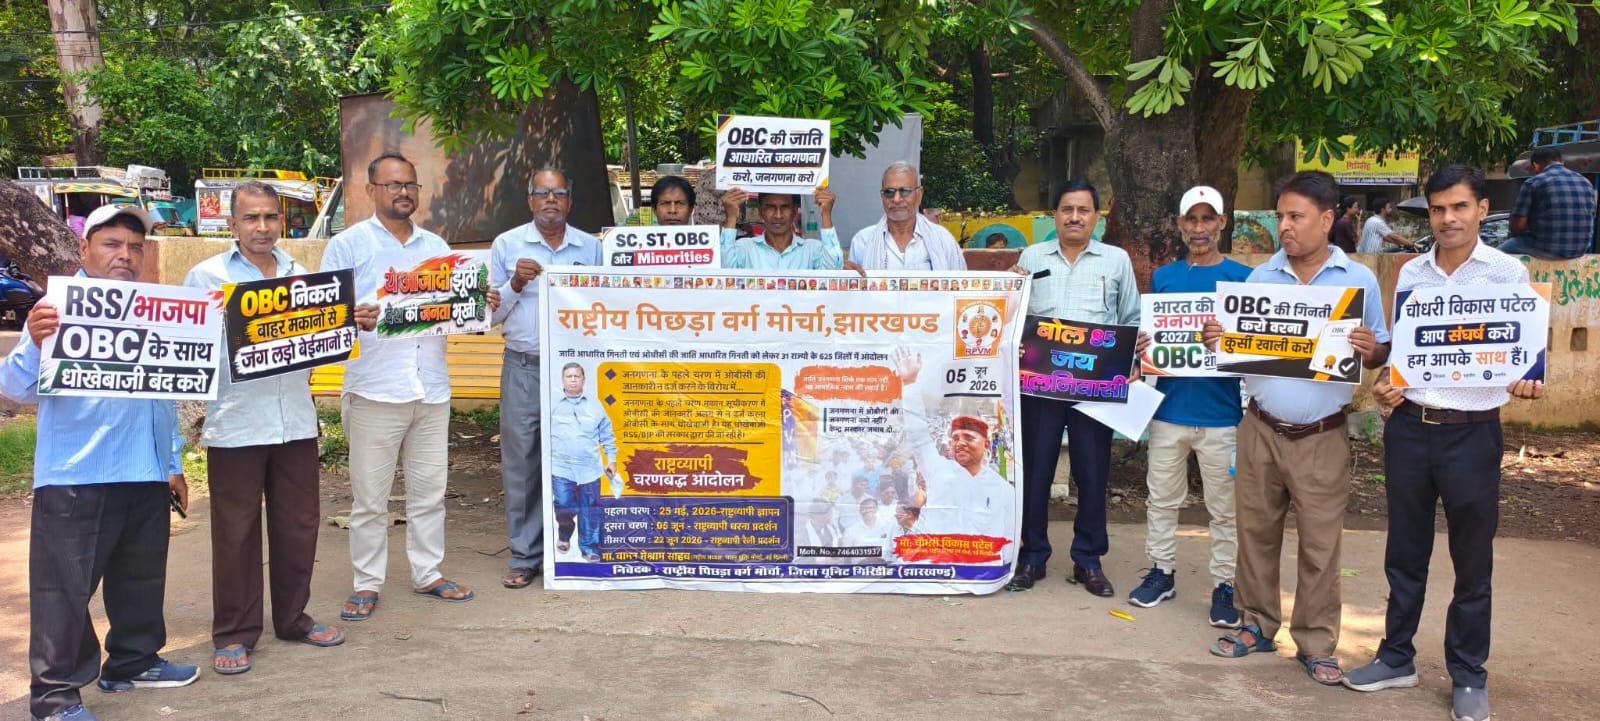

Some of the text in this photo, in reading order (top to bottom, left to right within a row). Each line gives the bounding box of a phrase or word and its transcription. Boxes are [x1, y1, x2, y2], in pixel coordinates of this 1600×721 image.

[727, 127, 823, 146] OBC की जाति
[729, 150, 821, 165] आधारित जनगणना
[732, 171, 815, 184] करो, जनगणना करो
[616, 231, 709, 249] SC, ST, OBC
[613, 251, 710, 265] और Minorities
[399, 262, 450, 294] आजादी
[240, 275, 342, 317] OBC निकले
[1153, 296, 1216, 313] भारत की
[1448, 294, 1496, 316] विकास
[1500, 292, 1537, 313] पटेल
[65, 285, 208, 326] RSS/भाजपा
[405, 303, 418, 322] की
[419, 304, 451, 322] जनता
[452, 296, 476, 326] भूखी
[1224, 294, 1333, 318] OBC की गिनती
[288, 308, 325, 332] मकानों
[327, 307, 337, 326] से
[557, 301, 630, 337] राष्ट्रीय
[635, 302, 716, 337] पिछड़ा
[722, 303, 760, 332] वर्ग
[1240, 318, 1303, 334] करो वरना
[1036, 318, 1117, 349] बोल 85
[1160, 332, 1190, 343] 2027
[1331, 326, 1348, 334] OBC
[1420, 322, 1516, 343] आप संघर्ष करो
[61, 326, 213, 362] OBC के साथ
[241, 328, 353, 369] जंग लड़ो बेईमानों से
[965, 347, 992, 355] RPVM
[1224, 335, 1314, 354] कुर्सी खाली करो
[558, 349, 576, 358] जाति
[577, 349, 605, 358] आधारित
[606, 349, 627, 359] गिनती
[629, 350, 640, 359] एवं
[642, 349, 667, 359] ओबीसी
[669, 350, 679, 359] की
[680, 350, 697, 359] जाति
[699, 350, 727, 360] आधारित
[728, 350, 750, 360] गिनती
[750, 351, 760, 360] को
[762, 351, 780, 360] लेकर
[781, 352, 789, 360] 31
[810, 351, 818, 360] के
[819, 352, 833, 360] 625
[860, 351, 889, 361] आंदोलन
[1049, 349, 1098, 373] जय
[1152, 345, 1203, 369] OBC
[1407, 353, 1427, 369] हम
[1430, 348, 1472, 367] आपके
[1475, 351, 1509, 365] साथ
[61, 363, 208, 393] धोखेबाजी बंद करो
[622, 369, 766, 380] जनगणना के पहले चरण ओबीसी की
[946, 366, 988, 384] 05 जून
[622, 381, 656, 391] जानकारी
[969, 380, 998, 391] 2026
[654, 454, 713, 474] राष्ट्रव्यापी
[633, 471, 745, 488] चरणबद्ध आंदोलन
[604, 507, 627, 517] पहला
[630, 507, 650, 516] चरण
[659, 507, 671, 516] 25
[604, 522, 625, 532] दूसरा
[628, 522, 648, 530] चरण
[671, 522, 685, 533] जून
[752, 521, 778, 532] प्रदर्शन
[628, 536, 647, 544] चरण
[653, 536, 665, 544] 22
[681, 536, 702, 544] 2026
[799, 548, 881, 556] Mob. 7464031937
[612, 564, 652, 575] निवेदक
[662, 565, 696, 577] राष्ट्रीय
[699, 565, 731, 578] पिछड़ा
[734, 565, 751, 577] वर्ग
[789, 566, 818, 577] जिला
[821, 566, 850, 579] यूनिट
